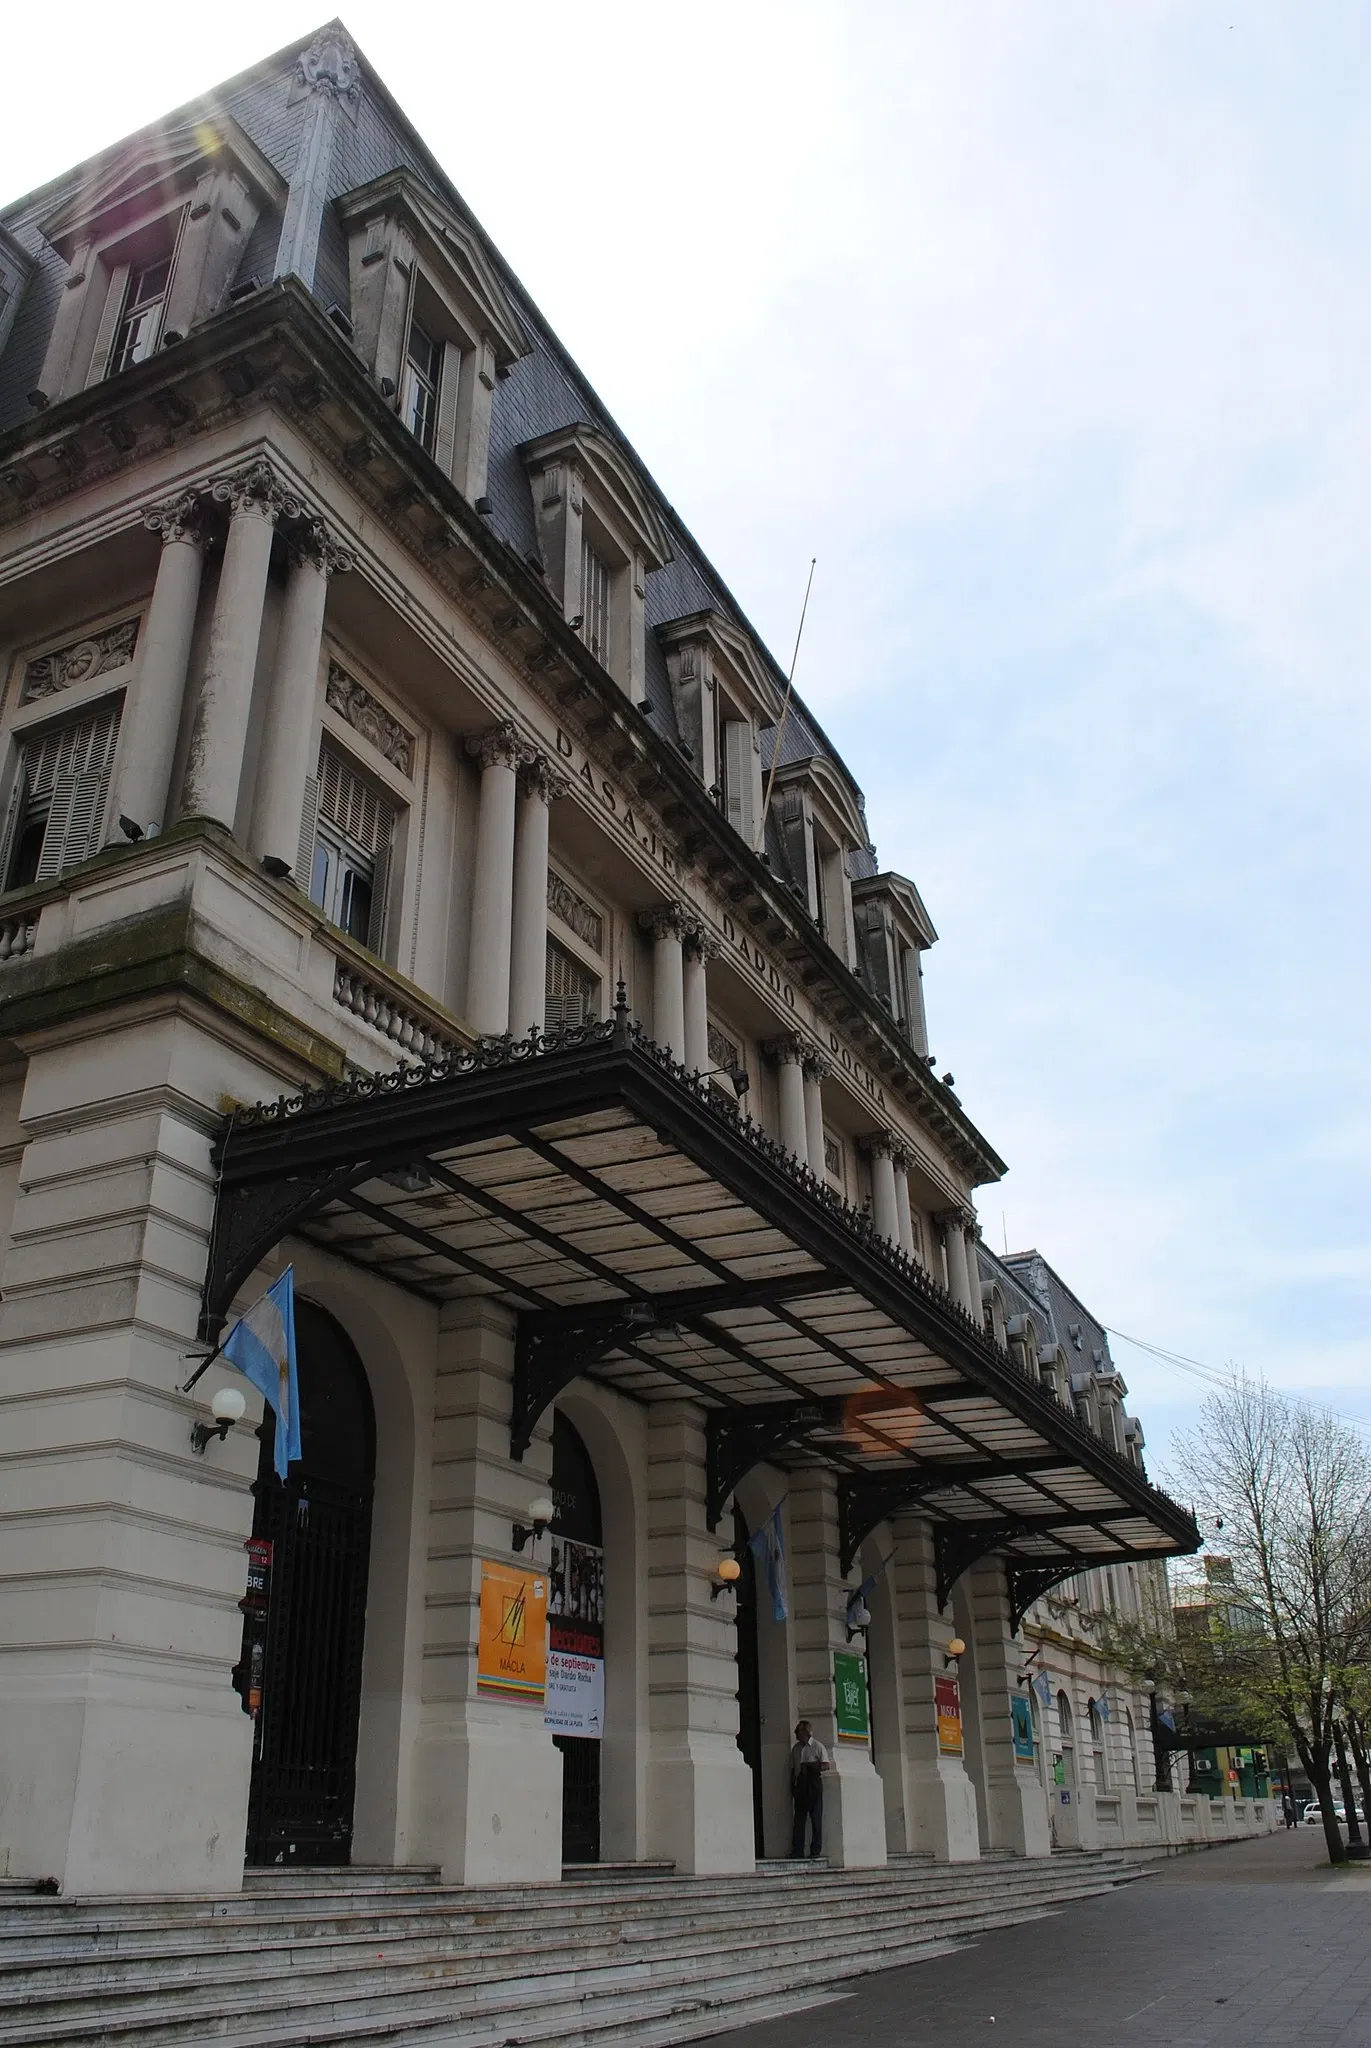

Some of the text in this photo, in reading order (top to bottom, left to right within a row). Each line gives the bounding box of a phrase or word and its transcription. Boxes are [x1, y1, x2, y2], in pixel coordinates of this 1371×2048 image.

[499, 1657, 526, 1674] MACLA
[550, 1653, 559, 1666] de
[560, 1656, 596, 1673] septiembre
[560, 1669, 577, 1681] Dardo
